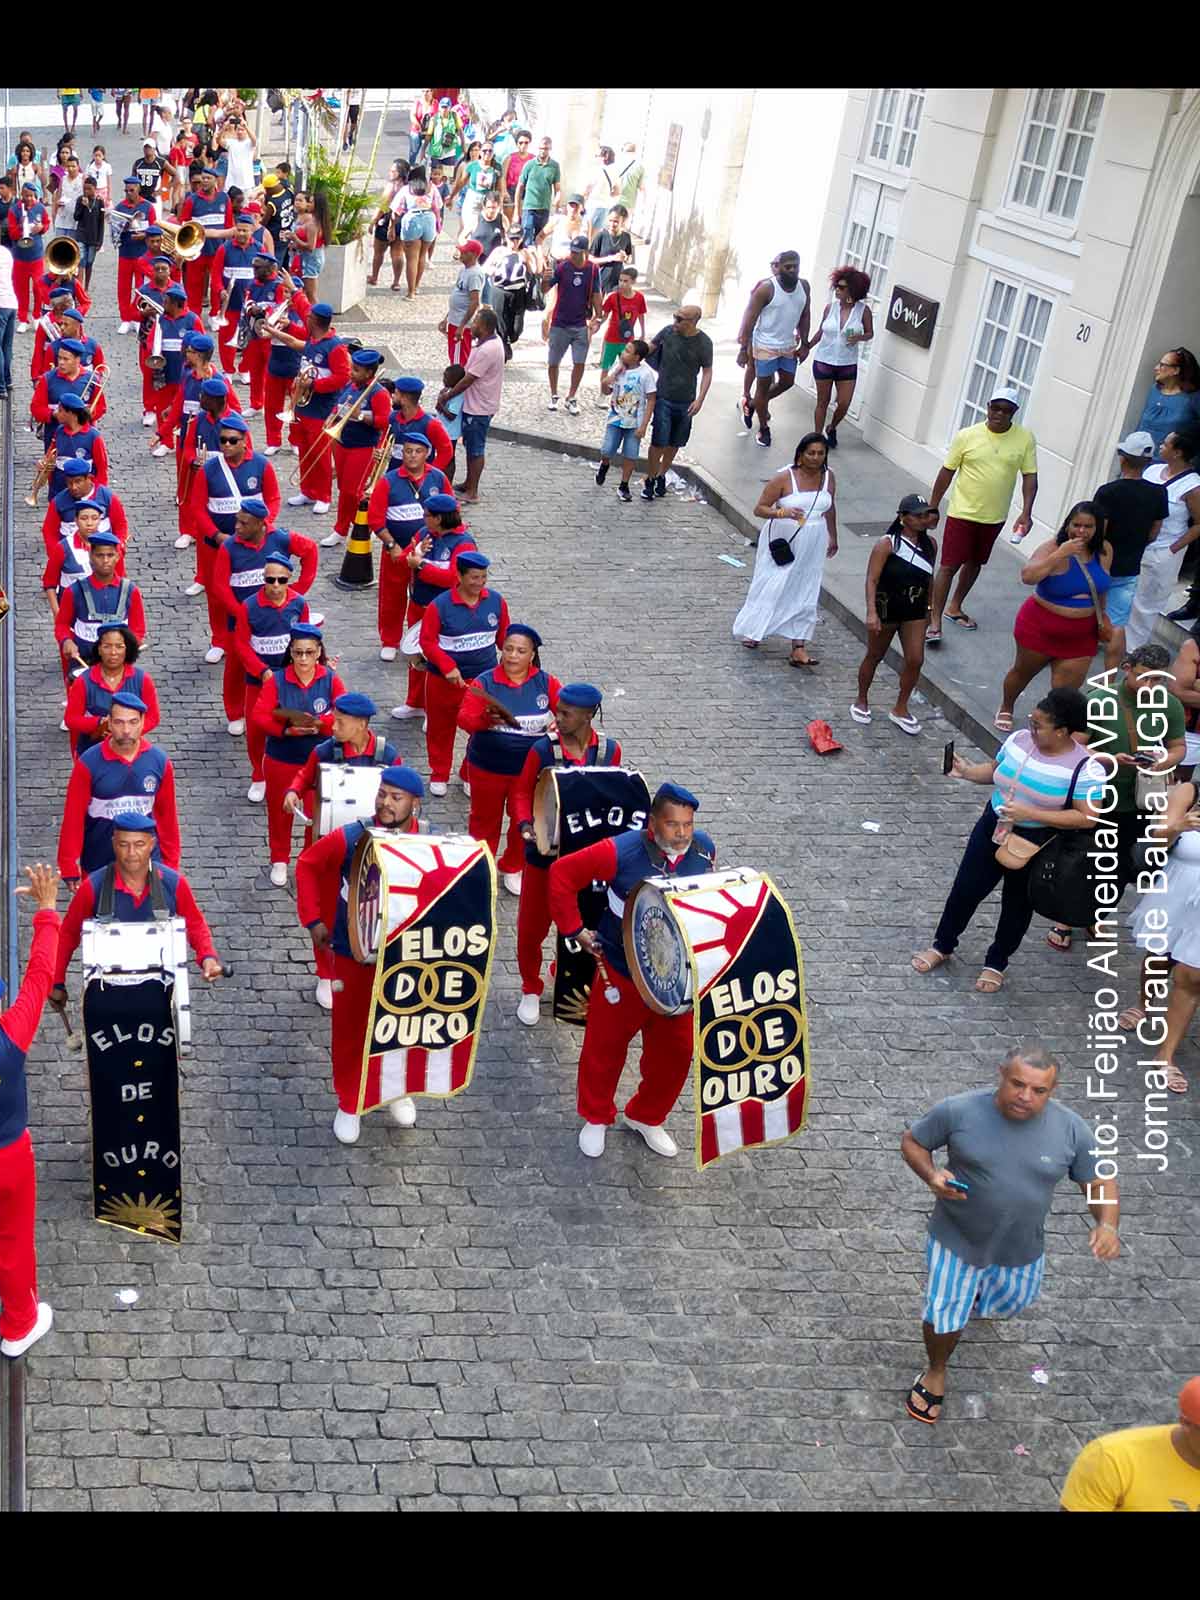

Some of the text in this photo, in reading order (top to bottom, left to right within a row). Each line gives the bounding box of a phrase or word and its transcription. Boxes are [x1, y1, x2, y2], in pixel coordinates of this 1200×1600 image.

[1076, 323, 1090, 343] 20
[566, 806, 647, 835] ELOS
[401, 924, 489, 962] ELOS
[710, 969, 797, 1018] ELOS
[91, 1022, 175, 1052] ELOS
[374, 1012, 469, 1046] OURO
[121, 1081, 153, 1102] DE
[702, 1055, 802, 1106] OURO
[103, 1141, 179, 1169] OURO
